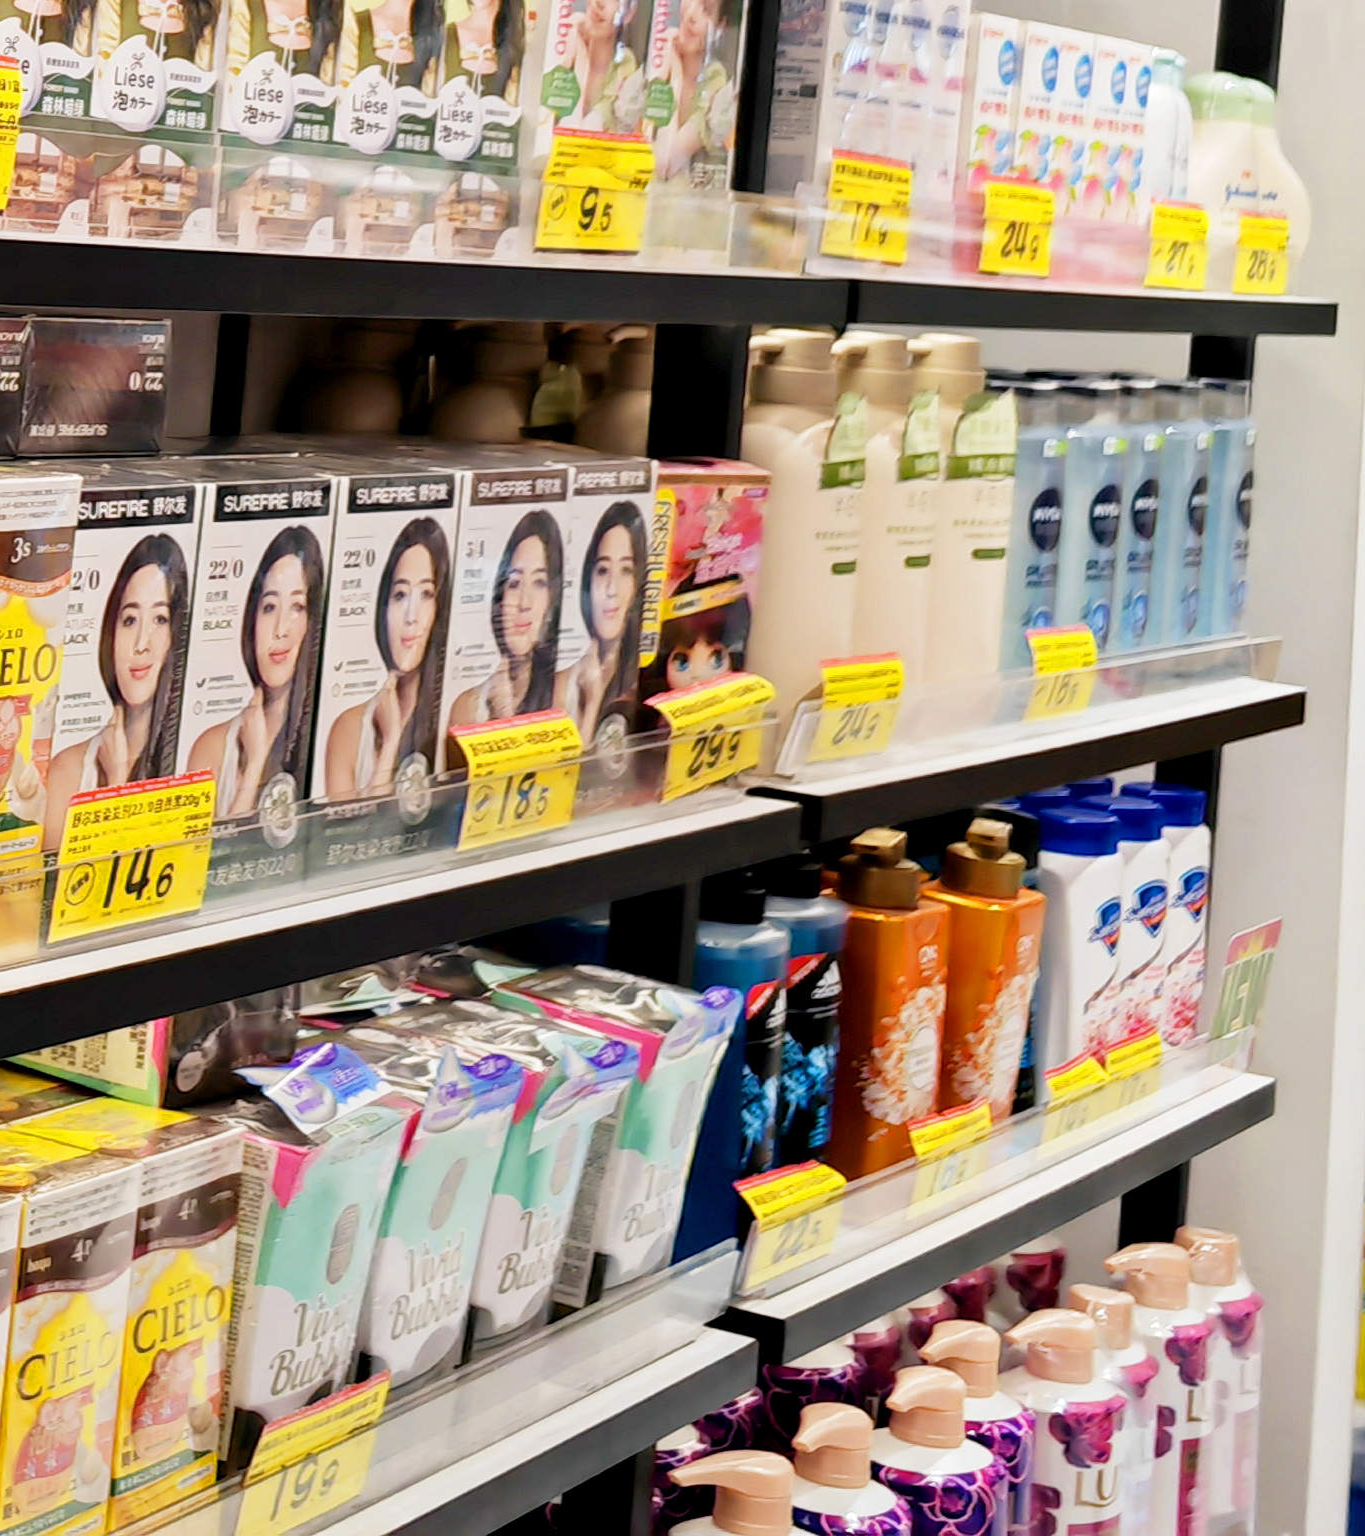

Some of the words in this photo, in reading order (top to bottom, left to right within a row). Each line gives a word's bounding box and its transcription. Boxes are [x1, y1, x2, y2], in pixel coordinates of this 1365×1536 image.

[113, 69, 155, 90] Liese
[243, 83, 285, 104] Liese
[350, 94, 389, 116] Liese
[439, 105, 474, 125] Liese
[355, 485, 417, 505] SUREFIRE
[476, 479, 532, 498] SUREFIRE
[77, 498, 149, 520] SUREFIRE
[223, 491, 288, 512] SUREFIRE
[343, 547, 376, 570] 22/0
[208, 557, 244, 582] 22/0
[339, 604, 368, 619] BLACK
[202, 619, 233, 632] BLACK
[102, 845, 174, 910] 14.6
[132, 1285, 227, 1355] CIELO
[17, 1330, 117, 1402] CIELO
